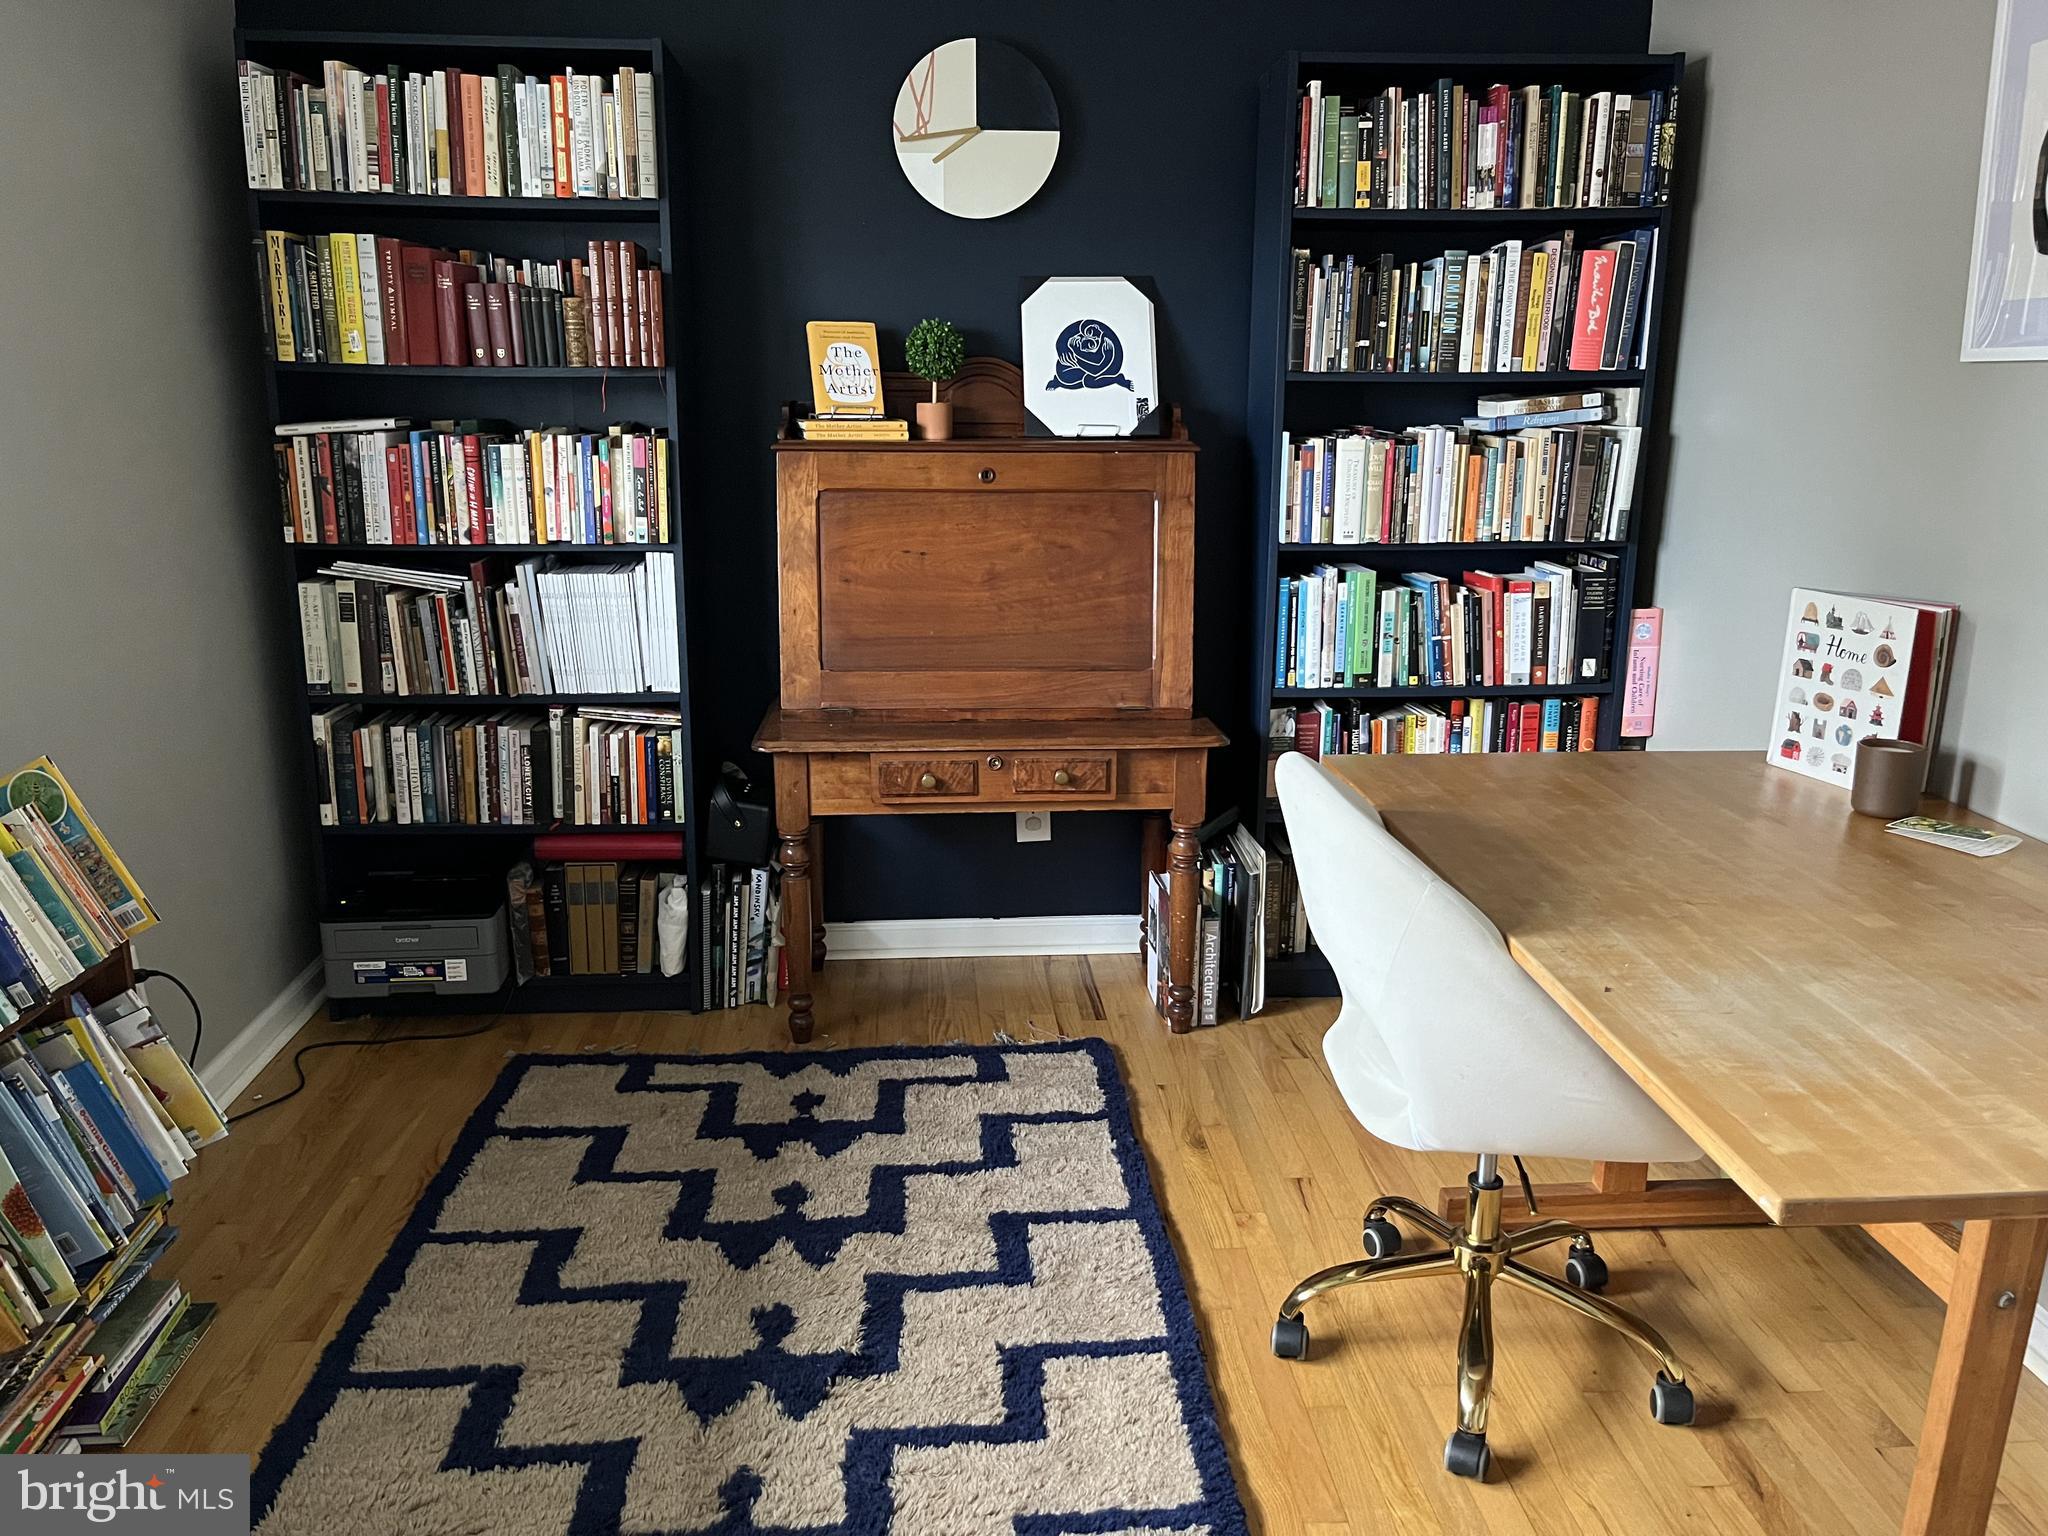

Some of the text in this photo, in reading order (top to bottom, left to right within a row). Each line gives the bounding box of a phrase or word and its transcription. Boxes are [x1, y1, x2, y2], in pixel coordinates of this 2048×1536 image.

[1651, 124, 1661, 166] BELIEVERS
[345, 266, 354, 293] STREET
[1510, 260, 1516, 268] IN
[271, 236, 286, 330] MARTYR!
[309, 271, 319, 309] SHATTERED
[327, 278, 332, 287] ON
[385, 251, 397, 331] TRINITY HYMNAL
[1543, 249, 1557, 330] DESIGNING MOTHERHOOD
[348, 296, 356, 324] WOMEN
[1442, 265, 1462, 334] DOMINION
[1505, 286, 1514, 317] COMPANY
[1622, 261, 1642, 338] LIVING WITH ART
[1505, 319, 1511, 328] OF
[831, 346, 862, 358] The
[1502, 329, 1510, 355] WOMEN
[819, 364, 878, 377] Mother
[826, 383, 874, 395] Artist
[1523, 413, 1560, 426] Religions
[467, 467, 476, 492] CRYING
[1345, 459, 1353, 493] CHRISTIAN
[471, 509, 479, 530] MART
[1606, 578, 1616, 617] BRAIN
[1515, 612, 1520, 621] IN
[1825, 633, 1869, 664] Home
[1638, 657, 1646, 681] Nursing
[411, 768, 420, 801] HOME
[576, 773, 583, 782] US
[658, 759, 666, 805] CONSPIRACY
[753, 874, 761, 917] KANDINSKY
[1203, 934, 1217, 1006] Architecture
[102, 1262, 153, 1319] THIS IS AMERICA
